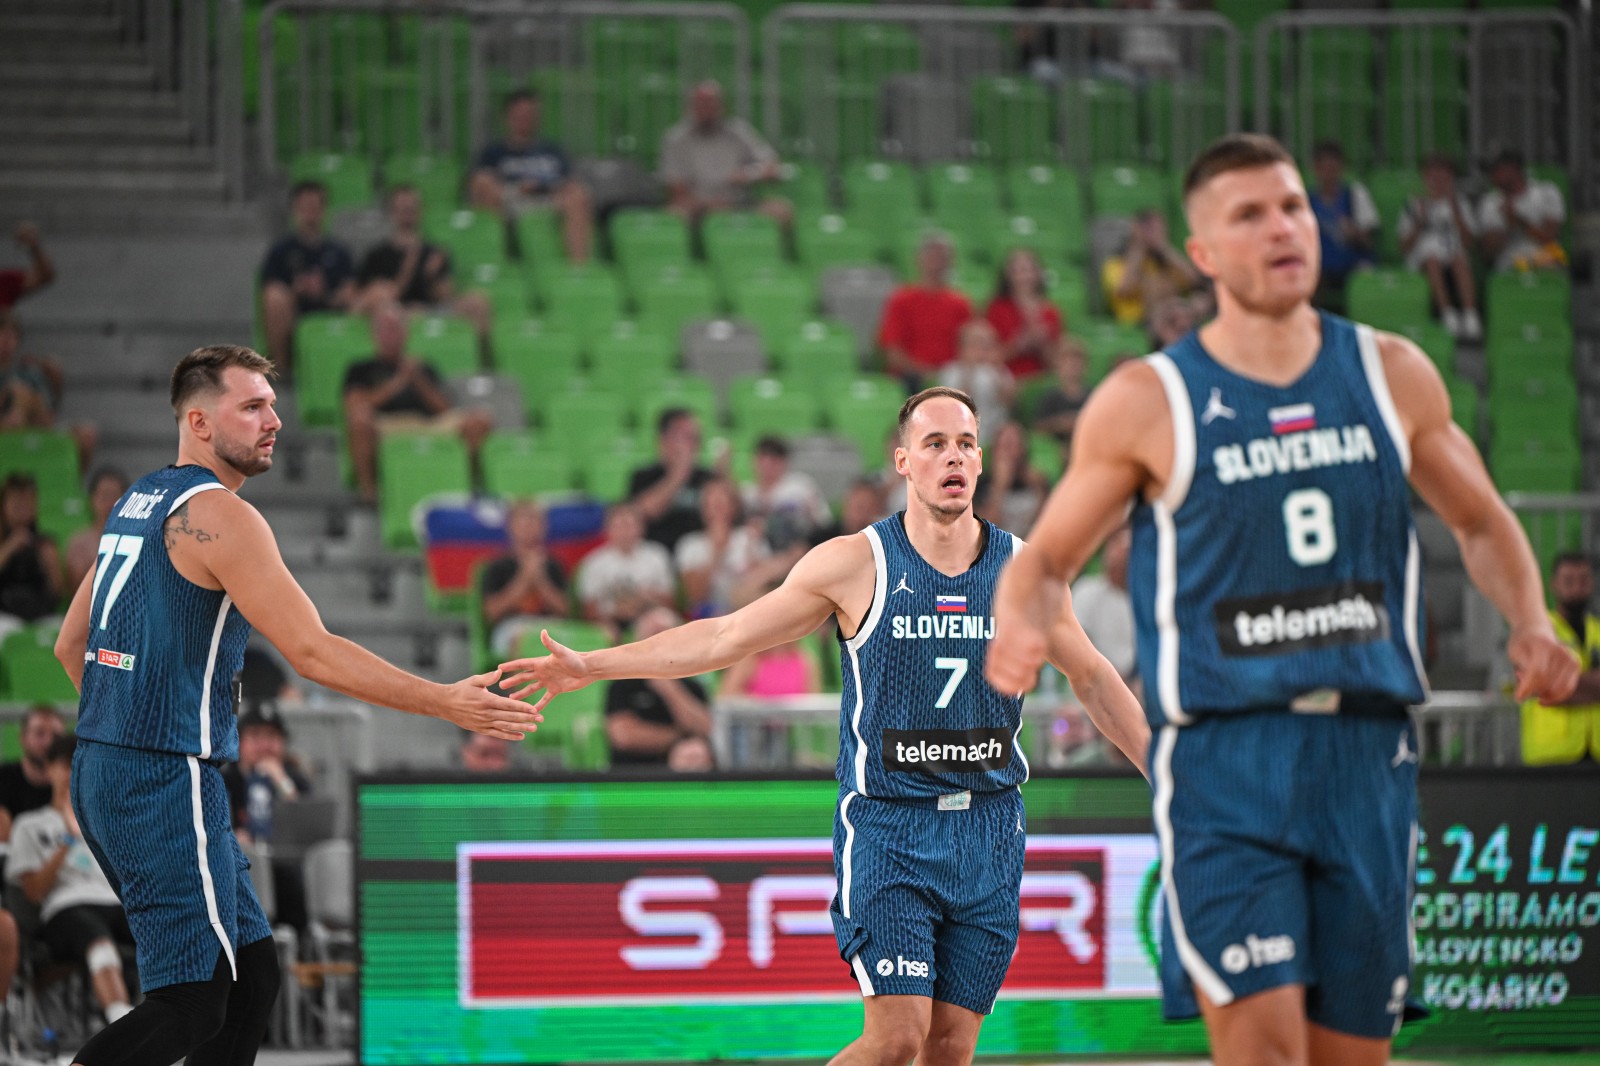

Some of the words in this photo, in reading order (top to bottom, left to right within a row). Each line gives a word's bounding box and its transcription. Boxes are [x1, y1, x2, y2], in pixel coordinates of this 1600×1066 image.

[1212, 424, 1377, 484] SLOVENIJA
[1283, 487, 1337, 567] 8
[89, 533, 144, 631] 77
[892, 615, 996, 640] SLOVENIJ
[934, 657, 969, 709] 7
[896, 738, 1002, 763] telemach
[1442, 822, 1513, 884] 24
[1527, 822, 1600, 885] LE
[618, 871, 1098, 970] SPR
[1412, 891, 1600, 929] ODPIRAMO
[897, 955, 929, 978] hse
